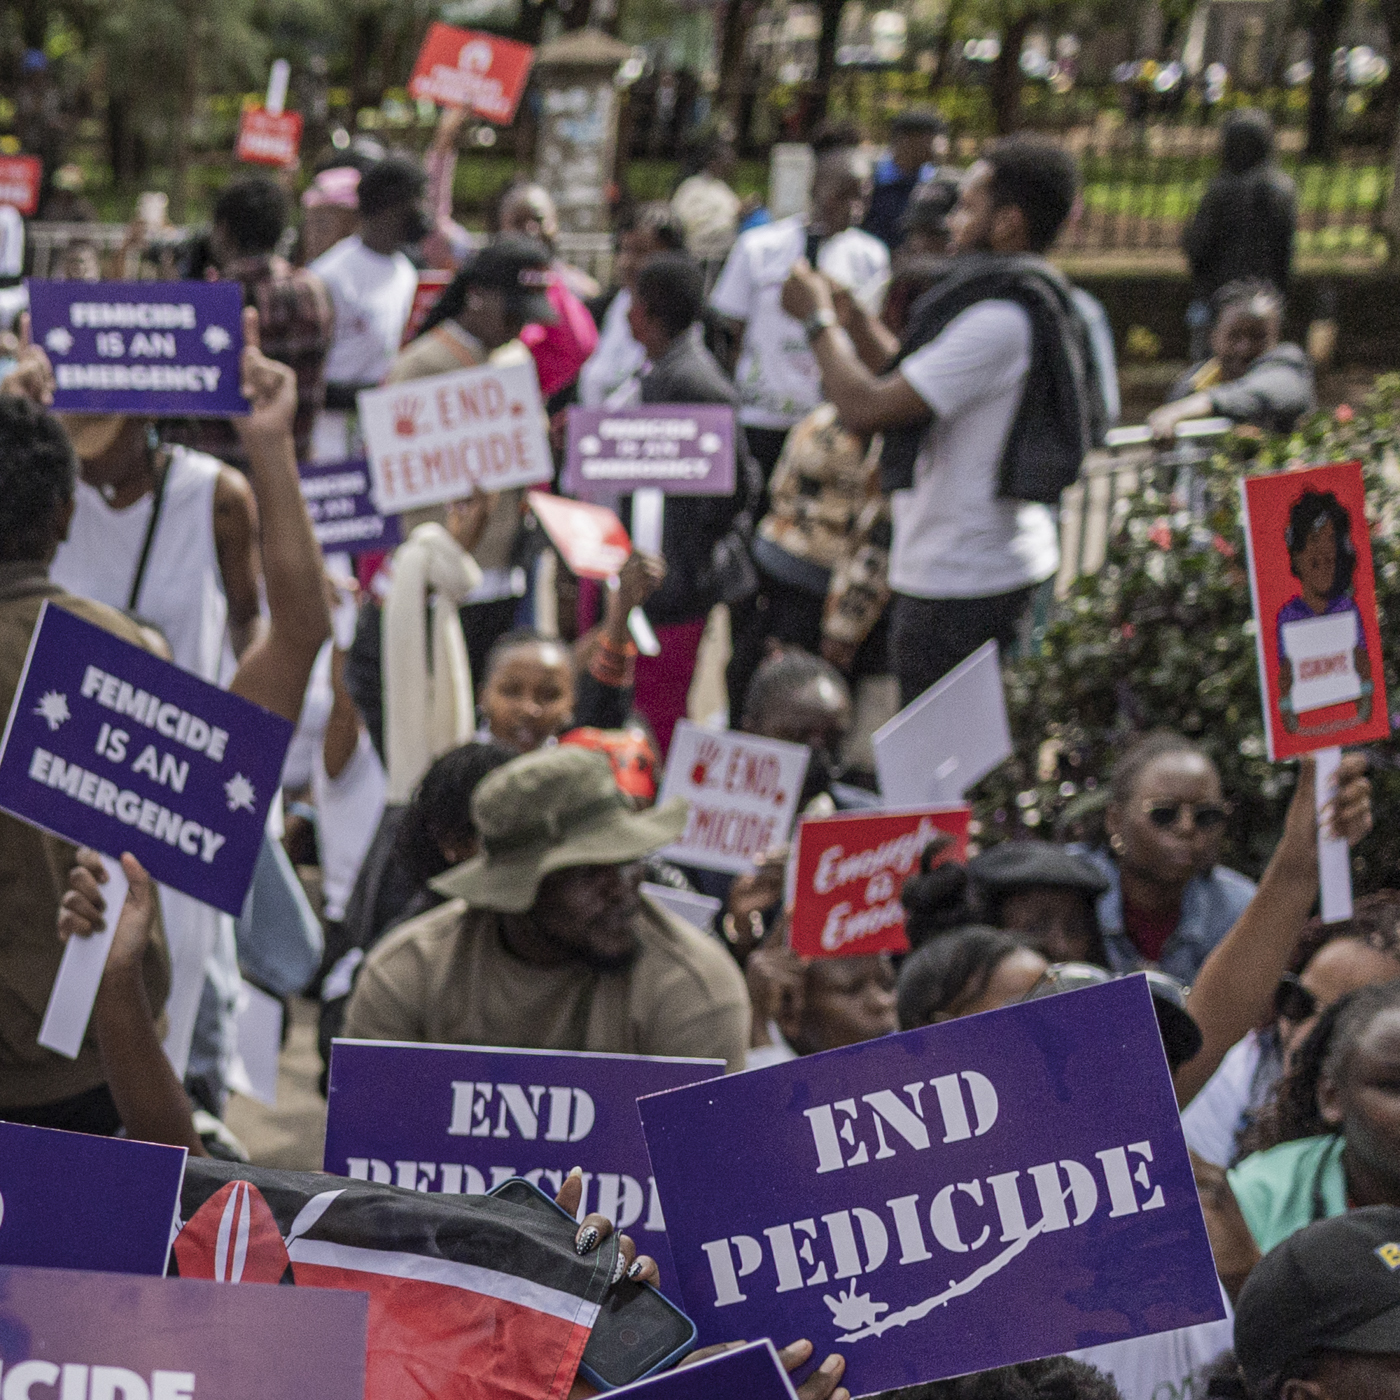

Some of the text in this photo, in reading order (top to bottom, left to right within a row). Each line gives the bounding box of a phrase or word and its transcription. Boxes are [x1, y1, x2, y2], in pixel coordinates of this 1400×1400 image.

[70, 303, 196, 331] FEMICIDE
[96, 332, 177, 359] IS AN
[55, 364, 223, 394] EMERGENCY
[445, 382, 503, 429] END
[379, 428, 533, 497] FEMICIDE
[80, 665, 229, 762] FEMICIDE
[95, 722, 191, 794] IS AN
[28, 746, 226, 864] EMERGENCY
[447, 1079, 596, 1143] END
[802, 1069, 999, 1174] END
[701, 1139, 1166, 1309] PEDICIDE
